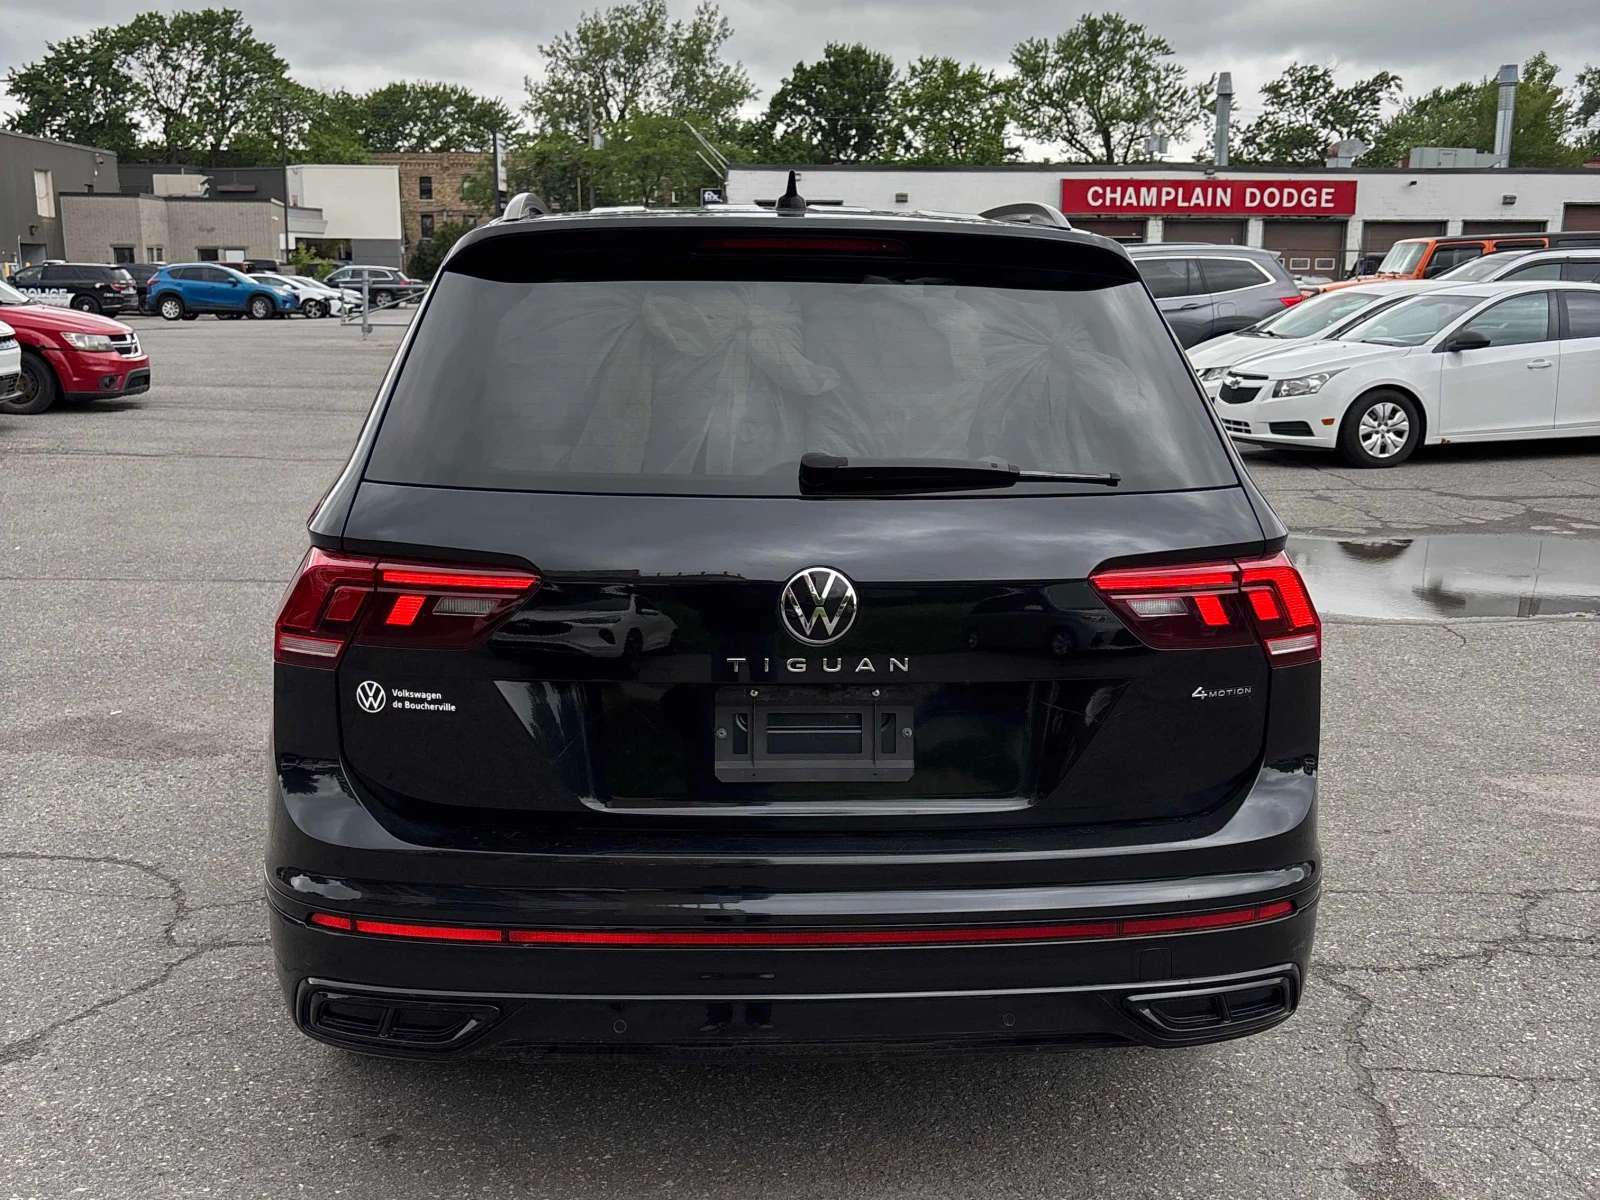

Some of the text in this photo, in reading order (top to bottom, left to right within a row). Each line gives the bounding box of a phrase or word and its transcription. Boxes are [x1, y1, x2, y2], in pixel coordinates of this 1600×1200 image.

[1087, 186, 1335, 208] CHAMPLAIN DODGE
[726, 657, 909, 673] TIGUAN
[392, 688, 442, 701] Volkswagen
[392, 700, 456, 712] de Boucherville
